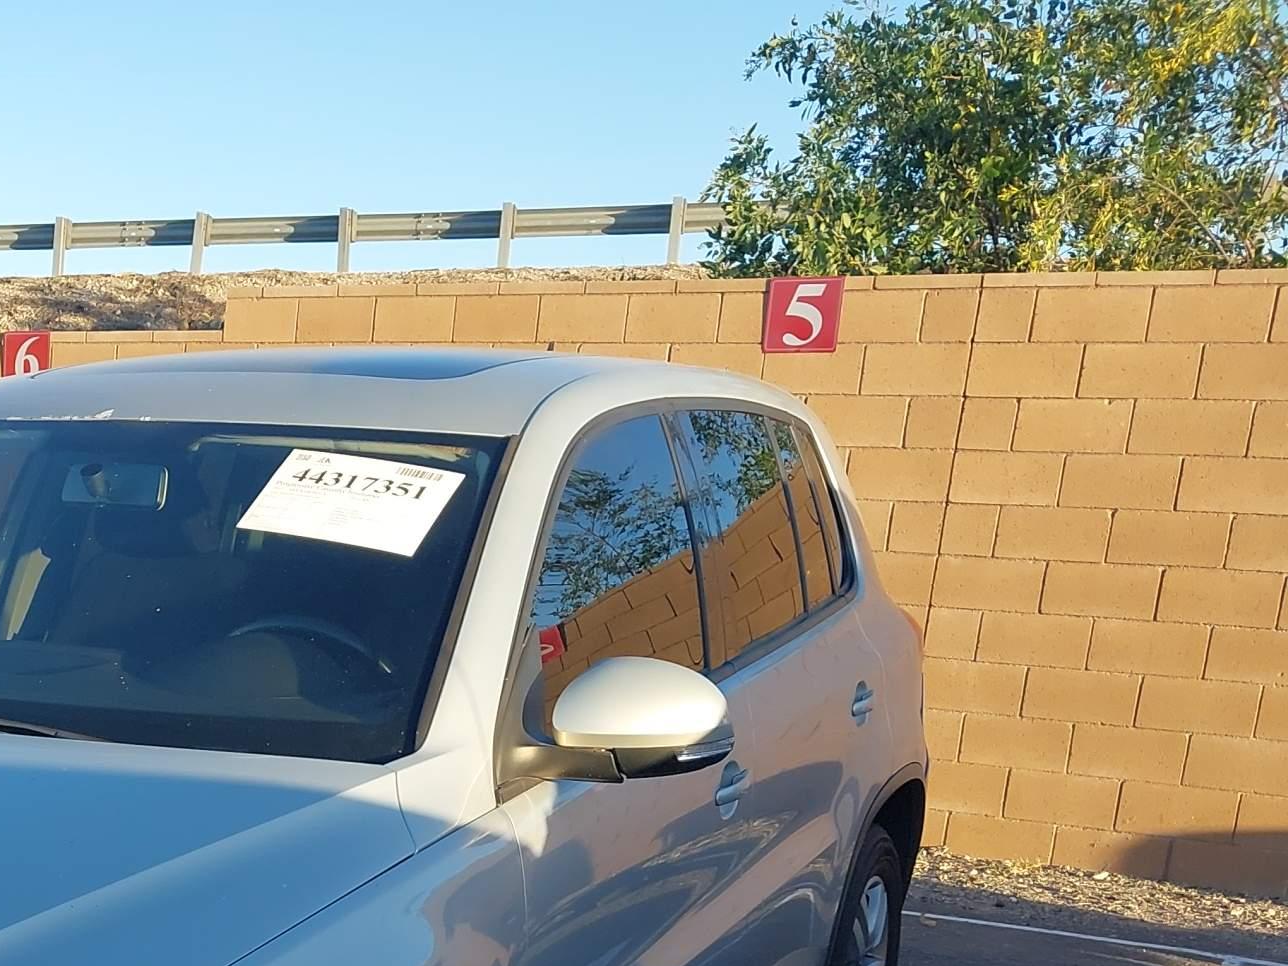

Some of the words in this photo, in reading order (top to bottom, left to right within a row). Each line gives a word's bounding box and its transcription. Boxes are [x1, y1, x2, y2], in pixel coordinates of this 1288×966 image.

[782, 283, 827, 346] 5
[15, 335, 41, 377] 6
[292, 468, 427, 499] 44317351
